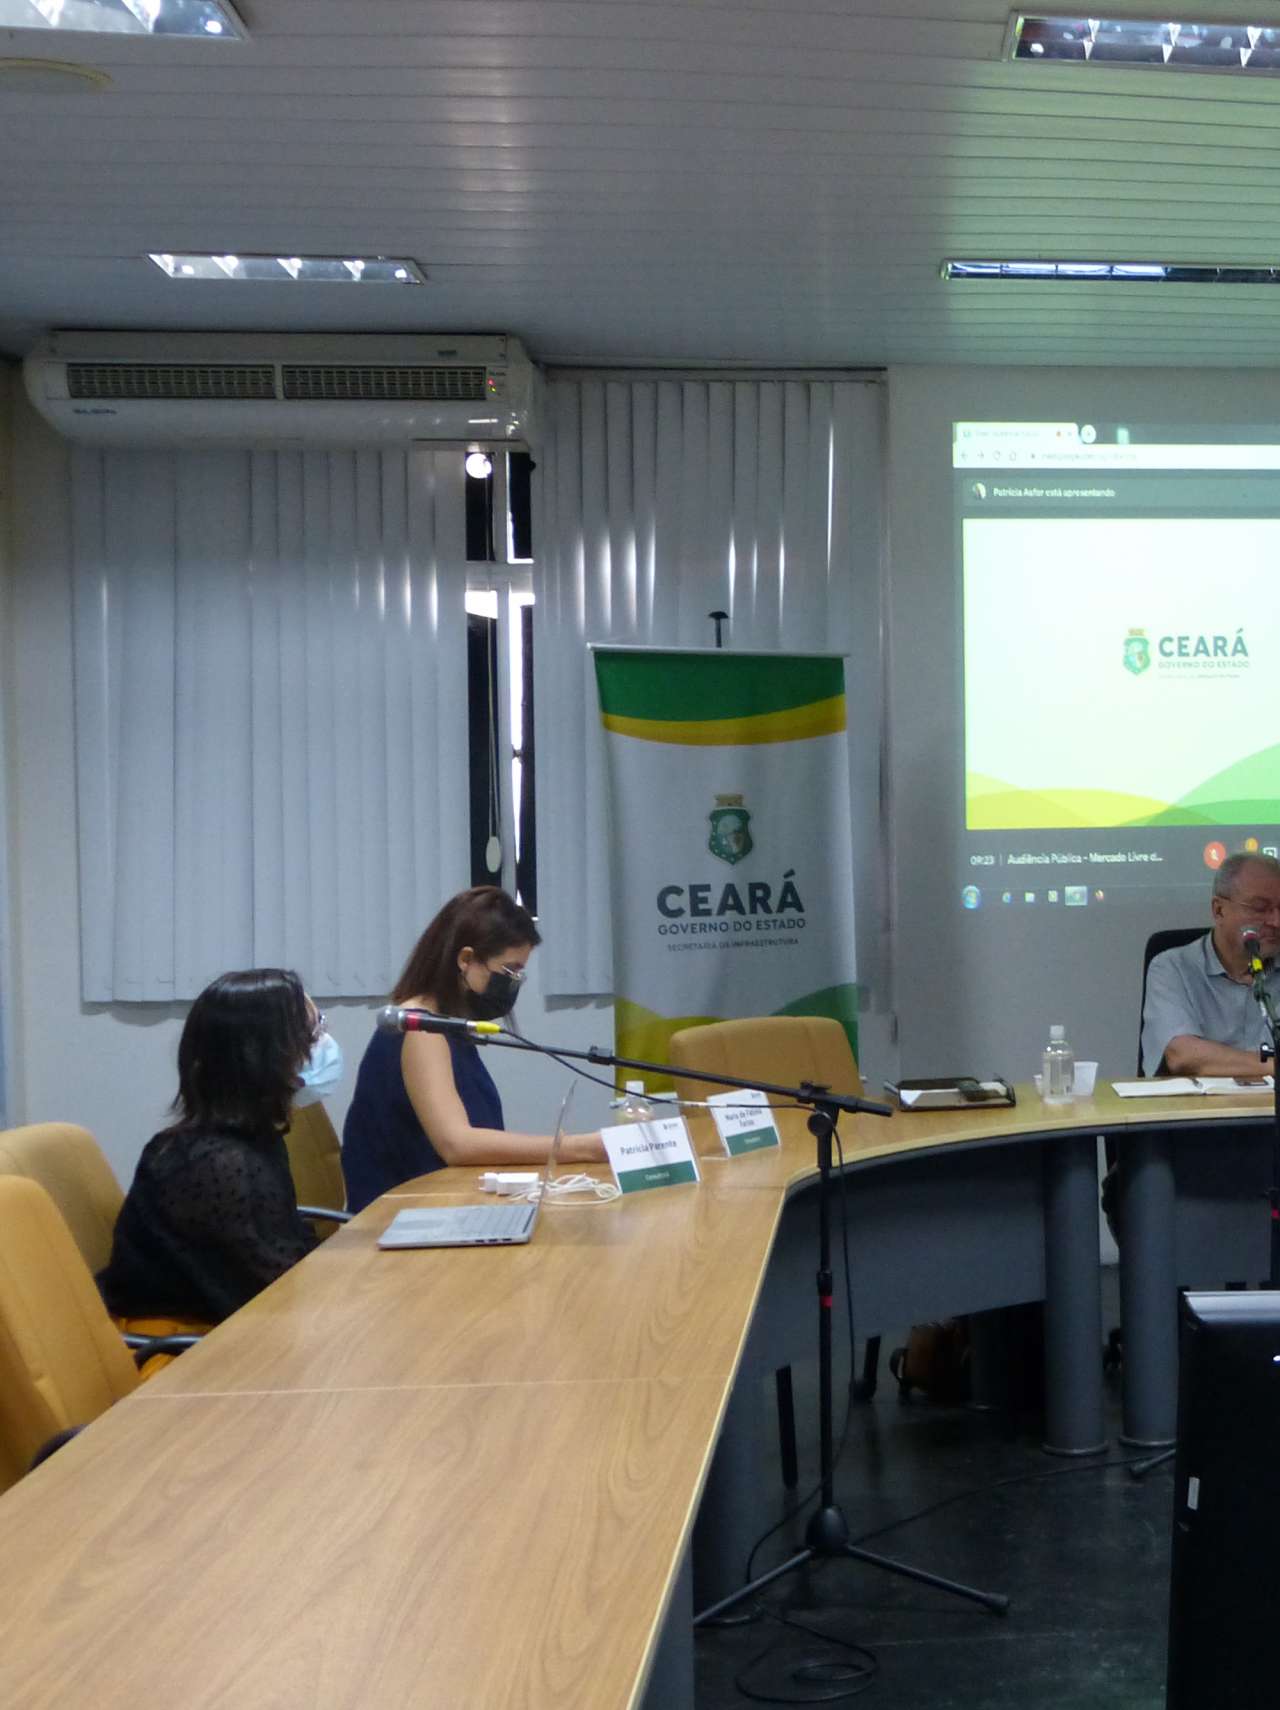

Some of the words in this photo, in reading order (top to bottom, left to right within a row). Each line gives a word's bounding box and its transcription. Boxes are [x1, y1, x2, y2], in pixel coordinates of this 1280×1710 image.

[1158, 627, 1249, 658] CEARÁ
[1158, 660, 1200, 669] GOVERNO
[1217, 660, 1249, 669] ESTADO
[1007, 852, 1050, 865] Audiência
[1088, 851, 1127, 864] Mercado
[656, 868, 805, 919] CEARÁ
[657, 920, 729, 936] GOVERNO
[732, 919, 753, 933] DO
[755, 917, 807, 931] ESTADO
